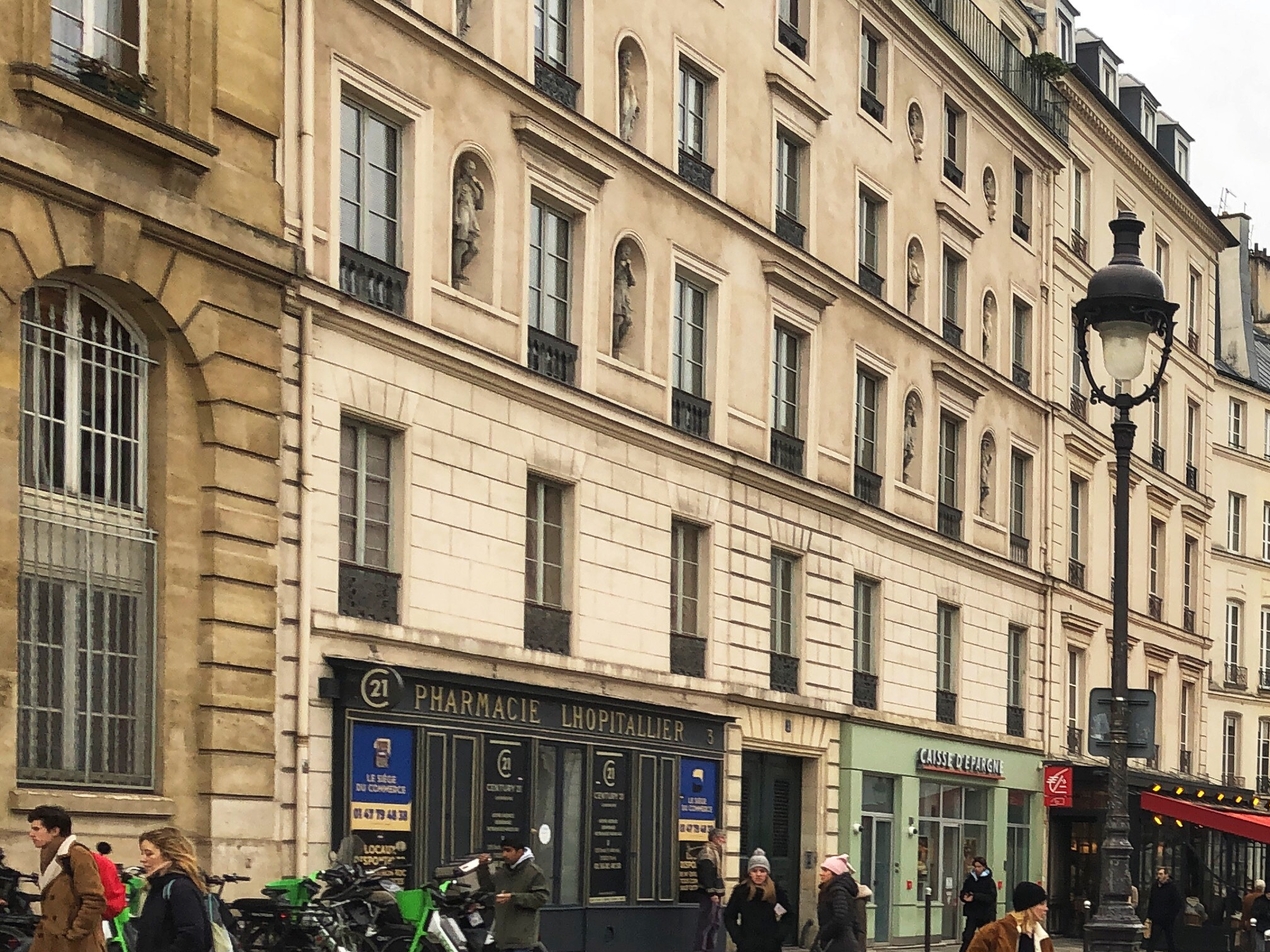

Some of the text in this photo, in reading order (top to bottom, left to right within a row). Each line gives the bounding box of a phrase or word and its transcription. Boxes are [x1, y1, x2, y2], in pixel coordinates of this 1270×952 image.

[414, 684, 714, 745] PHARMACIE LHOPITALLIER 3
[920, 748, 953, 769] CAISSE
[366, 773, 376, 783] LE
[356, 783, 406, 795] DU COMMERCE
